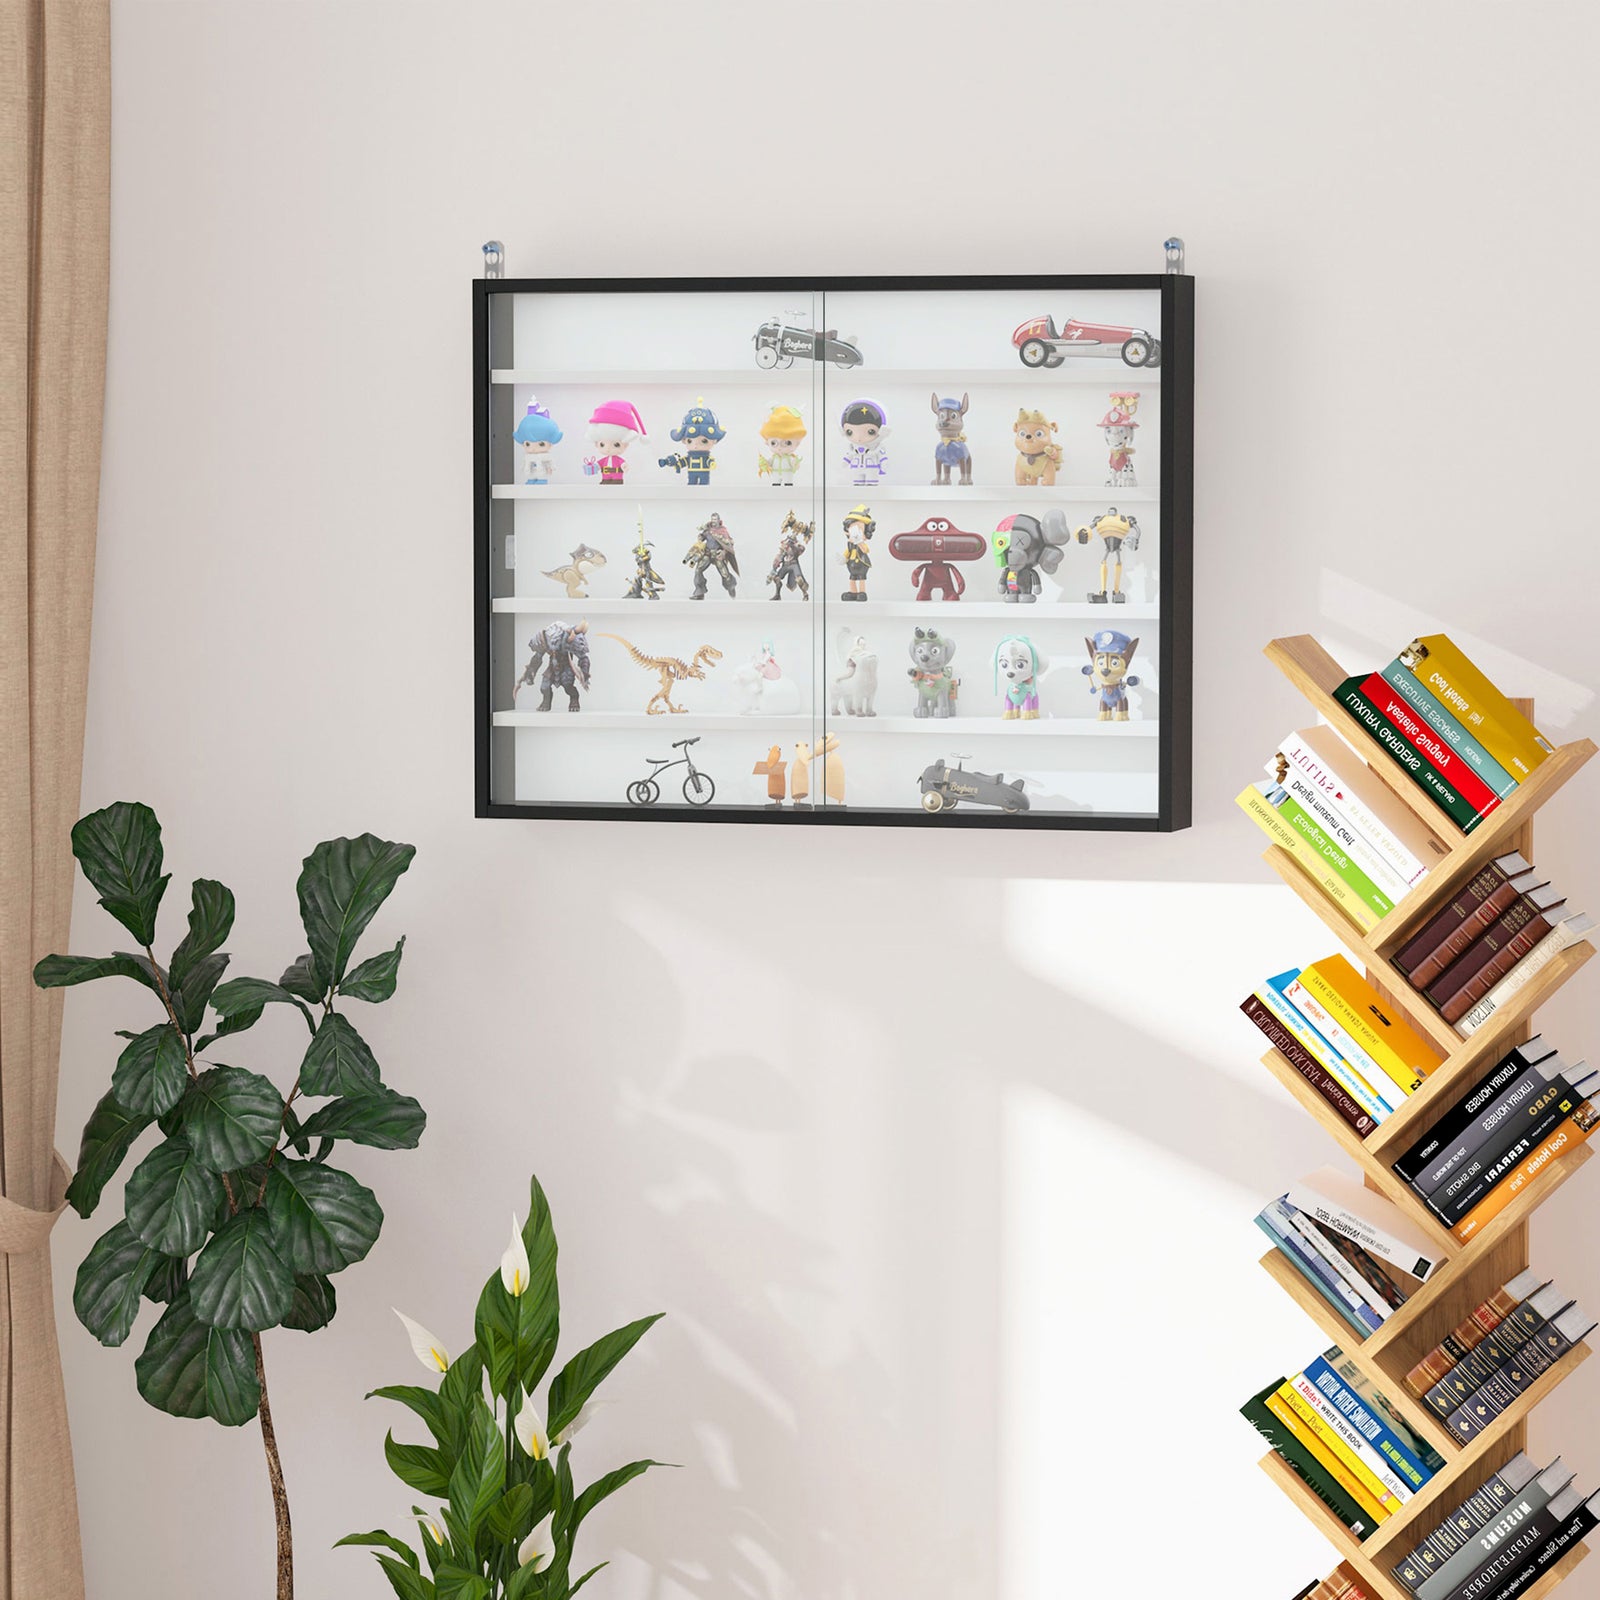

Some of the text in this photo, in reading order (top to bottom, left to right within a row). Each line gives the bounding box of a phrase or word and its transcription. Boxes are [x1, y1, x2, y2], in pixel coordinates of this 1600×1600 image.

[1285, 1392, 1304, 1411] Poet
[1301, 1385, 1322, 1407] Didn't
[1319, 1404, 1337, 1423] WRITE
[1334, 1420, 1349, 1435] THIS
[1345, 1432, 1363, 1450] BOOK
[1306, 1415, 1325, 1434] Poet
